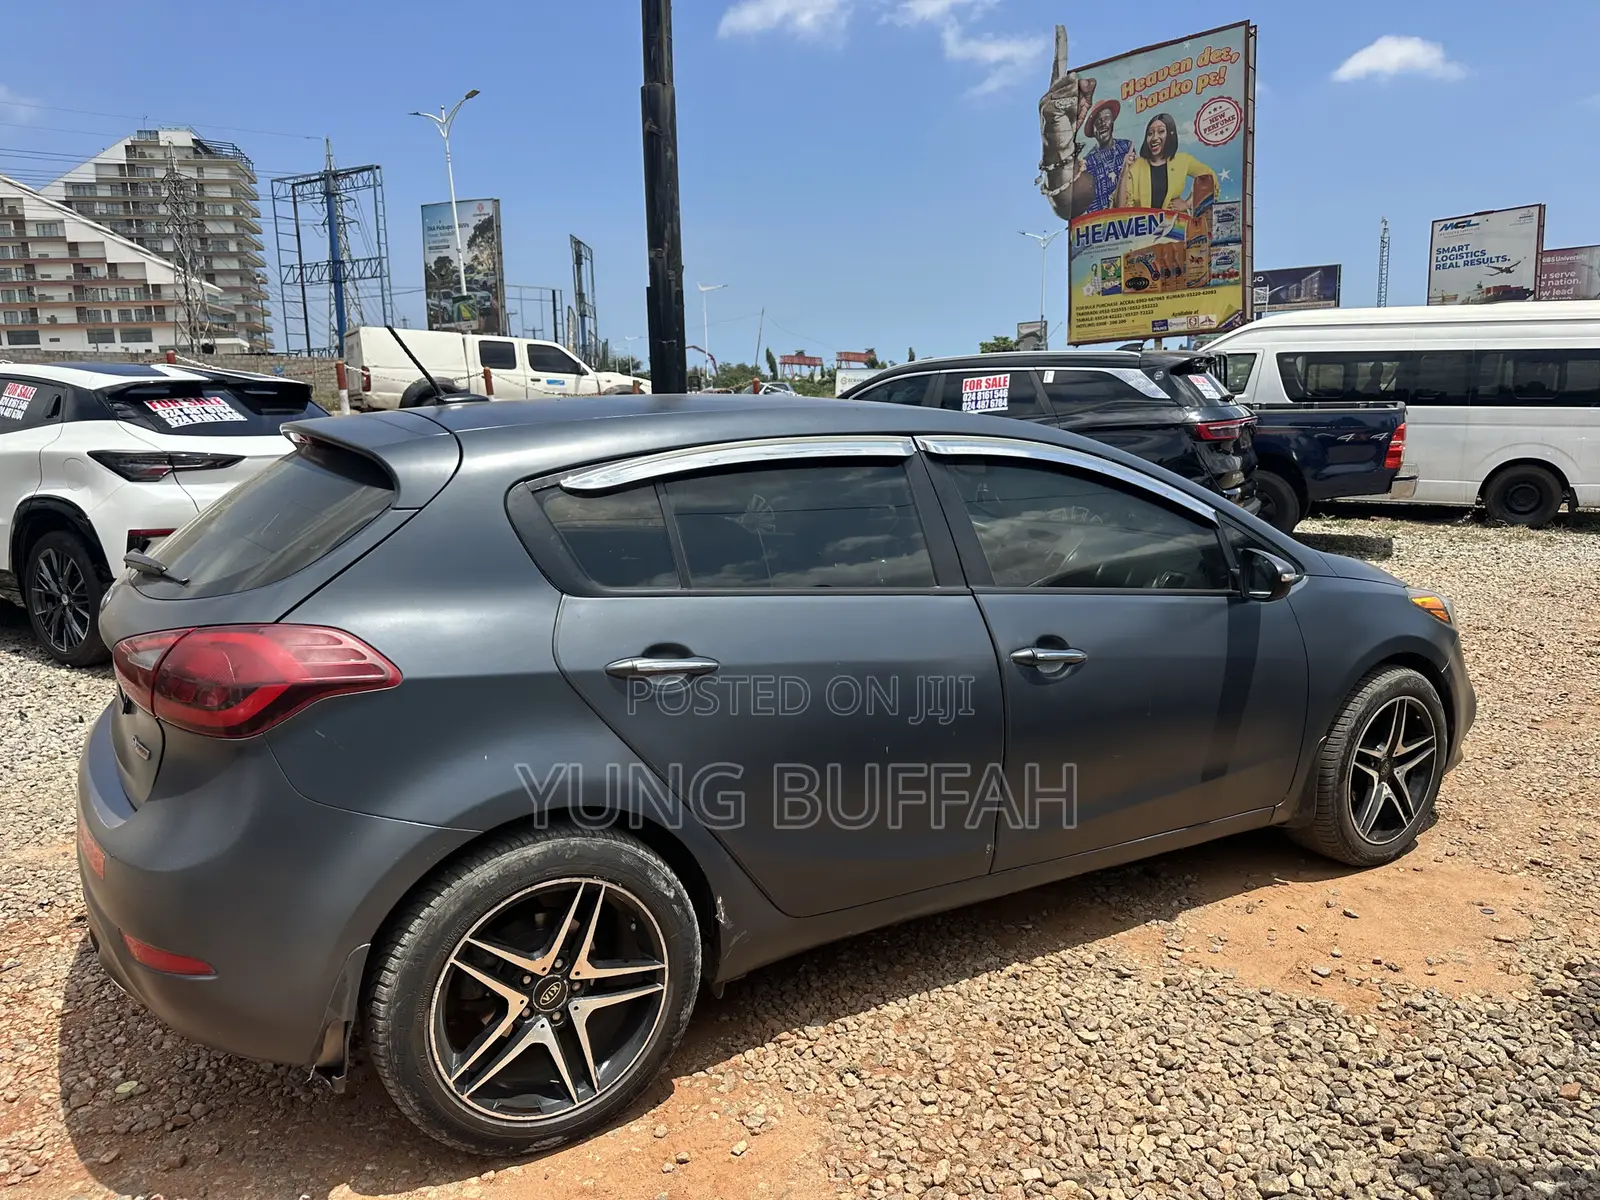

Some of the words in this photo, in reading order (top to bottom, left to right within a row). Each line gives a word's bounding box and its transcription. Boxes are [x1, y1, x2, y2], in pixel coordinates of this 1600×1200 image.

[1121, 57, 1193, 100] Heaven
[1135, 79, 1193, 114] baako
[1203, 115, 1236, 134] PERFUME
[1209, 112, 1226, 124] NEW
[1075, 211, 1165, 247] HEAVEN
[1435, 243, 1470, 255] SMART
[1435, 249, 1487, 263] LOGISTICS
[1435, 260, 1460, 271] REAL
[1463, 255, 1512, 268] RESULTS.
[1548, 277, 1581, 286] nation.
[1549, 271, 1576, 279] serve
[1553, 287, 1574, 296] lead
[1172, 310, 1192, 318] Available
[964, 379, 983, 391] FOR
[985, 376, 1009, 389] SALE
[5, 383, 20, 396] FOR
[17, 385, 36, 399] SALE
[963, 392, 976, 402] 024
[147, 399, 184, 410] FOR
[962, 401, 976, 411] 024
[542, 983, 561, 1004] KIA
